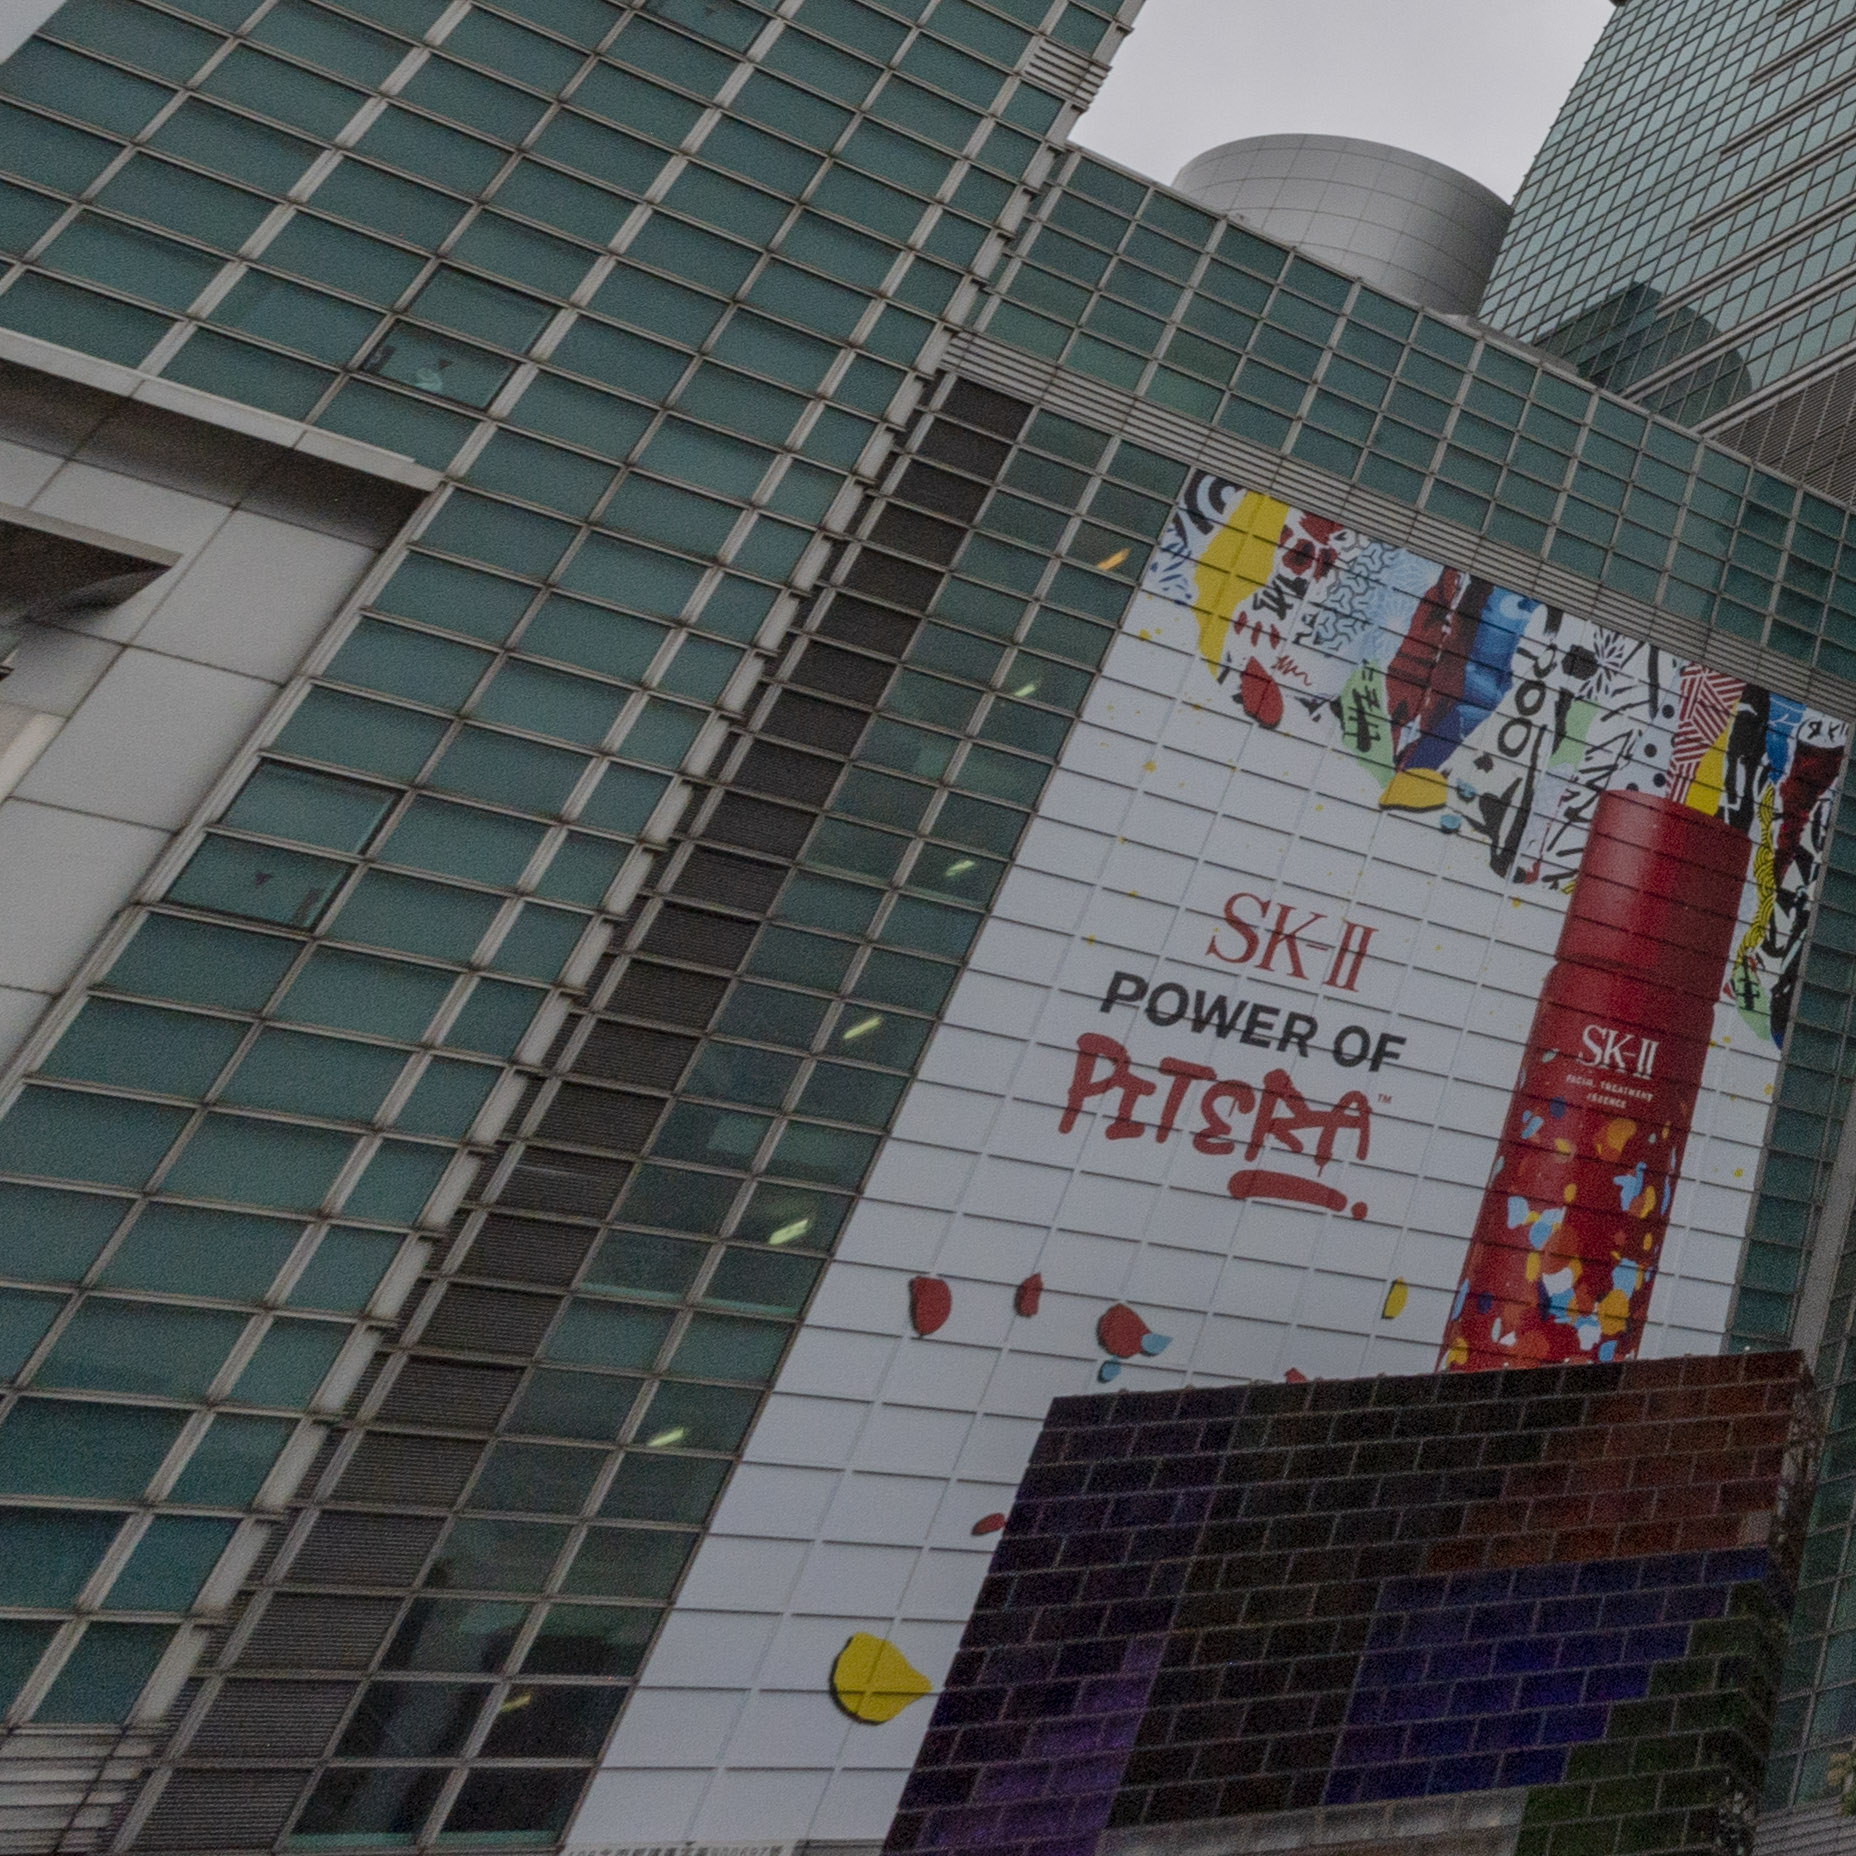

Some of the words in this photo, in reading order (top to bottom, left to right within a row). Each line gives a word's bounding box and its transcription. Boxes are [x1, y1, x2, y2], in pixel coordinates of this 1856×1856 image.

[1205, 892, 1379, 993] SK-II
[1099, 970, 1318, 1058] POWER
[1332, 1025, 1406, 1072] OF
[1576, 1024, 1660, 1080] SK-II
[1058, 1032, 1372, 1178] PITERA
